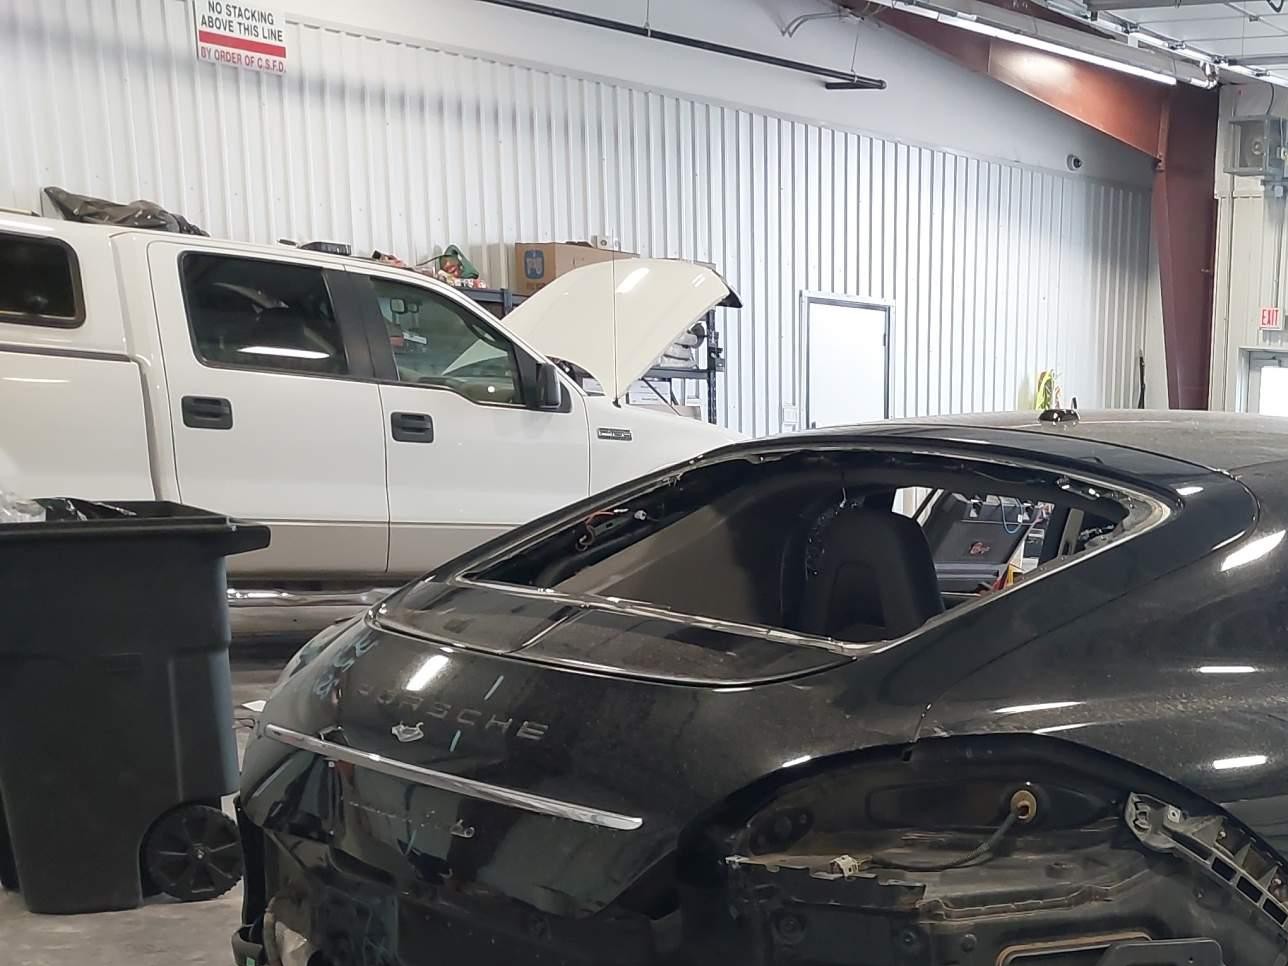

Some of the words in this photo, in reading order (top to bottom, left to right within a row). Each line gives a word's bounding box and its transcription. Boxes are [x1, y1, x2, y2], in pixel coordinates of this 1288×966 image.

[208, 0, 222, 14] NO
[225, 3, 274, 25] STACKING
[201, 14, 234, 33] ABOVE
[237, 21, 259, 38] THIS
[262, 27, 283, 42] LINE
[200, 46, 212, 59] BY
[214, 48, 242, 65] ORDER
[244, 54, 255, 67] OF
[1261, 309, 1279, 326] EXIT
